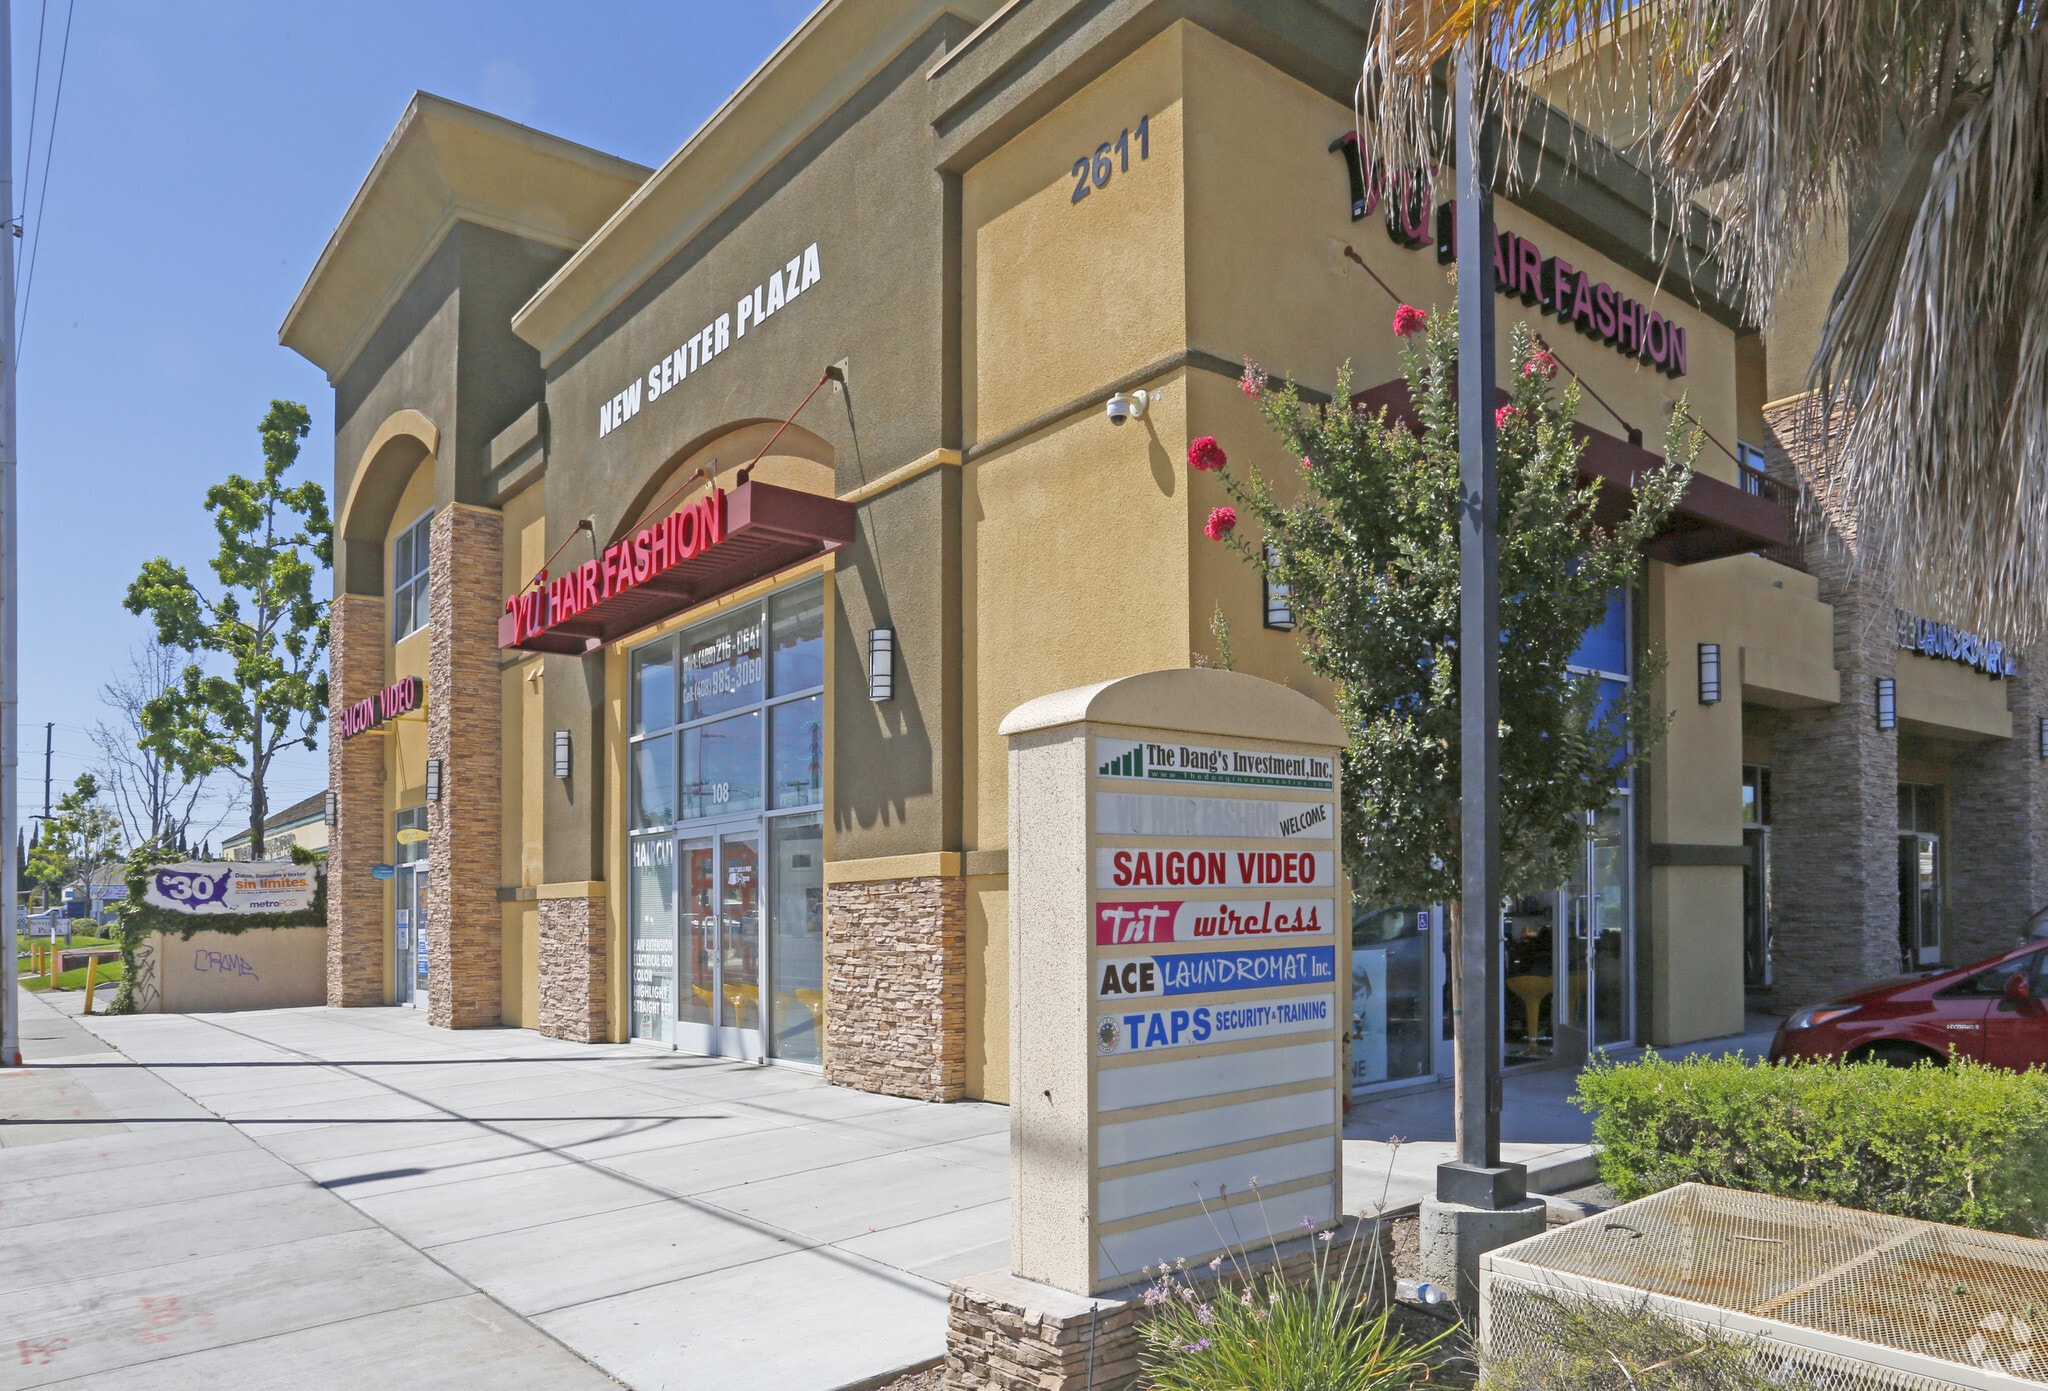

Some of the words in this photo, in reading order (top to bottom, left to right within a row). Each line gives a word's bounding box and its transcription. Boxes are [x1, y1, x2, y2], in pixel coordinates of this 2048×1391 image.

[1071, 114, 1149, 204] 2611
[1552, 255, 1688, 378] FASHION
[600, 377, 642, 439] NEW
[648, 312, 731, 403] SENTER
[737, 242, 822, 340] PLAZA
[549, 559, 602, 627] HAIR
[602, 488, 725, 599] FASHION
[339, 695, 375, 741] SAIGON
[380, 674, 415, 720] VIDEO
[1147, 744, 1175, 768] The
[1179, 747, 1229, 773] Dang's
[712, 781, 729, 804] 108
[1151, 796, 1198, 835] HAIR
[1202, 799, 1279, 837] FASHION
[1280, 804, 1327, 838] WELCOME
[235, 879, 257, 890] sin
[1113, 851, 1227, 886] SAIGON
[1237, 852, 1316, 884] VIDEO
[250, 899, 297, 908] metroPCS
[1193, 902, 1322, 937] wireless
[633, 968, 653, 982] COLOR
[1101, 963, 1154, 995] ACE
[1165, 954, 1307, 988] LAUNDROMAT
[1312, 958, 1331, 977] Inc.
[1123, 1007, 1212, 1049] TAPS
[1215, 1006, 1271, 1031] SECURITY
[1277, 1000, 1327, 1023] TRAINING
